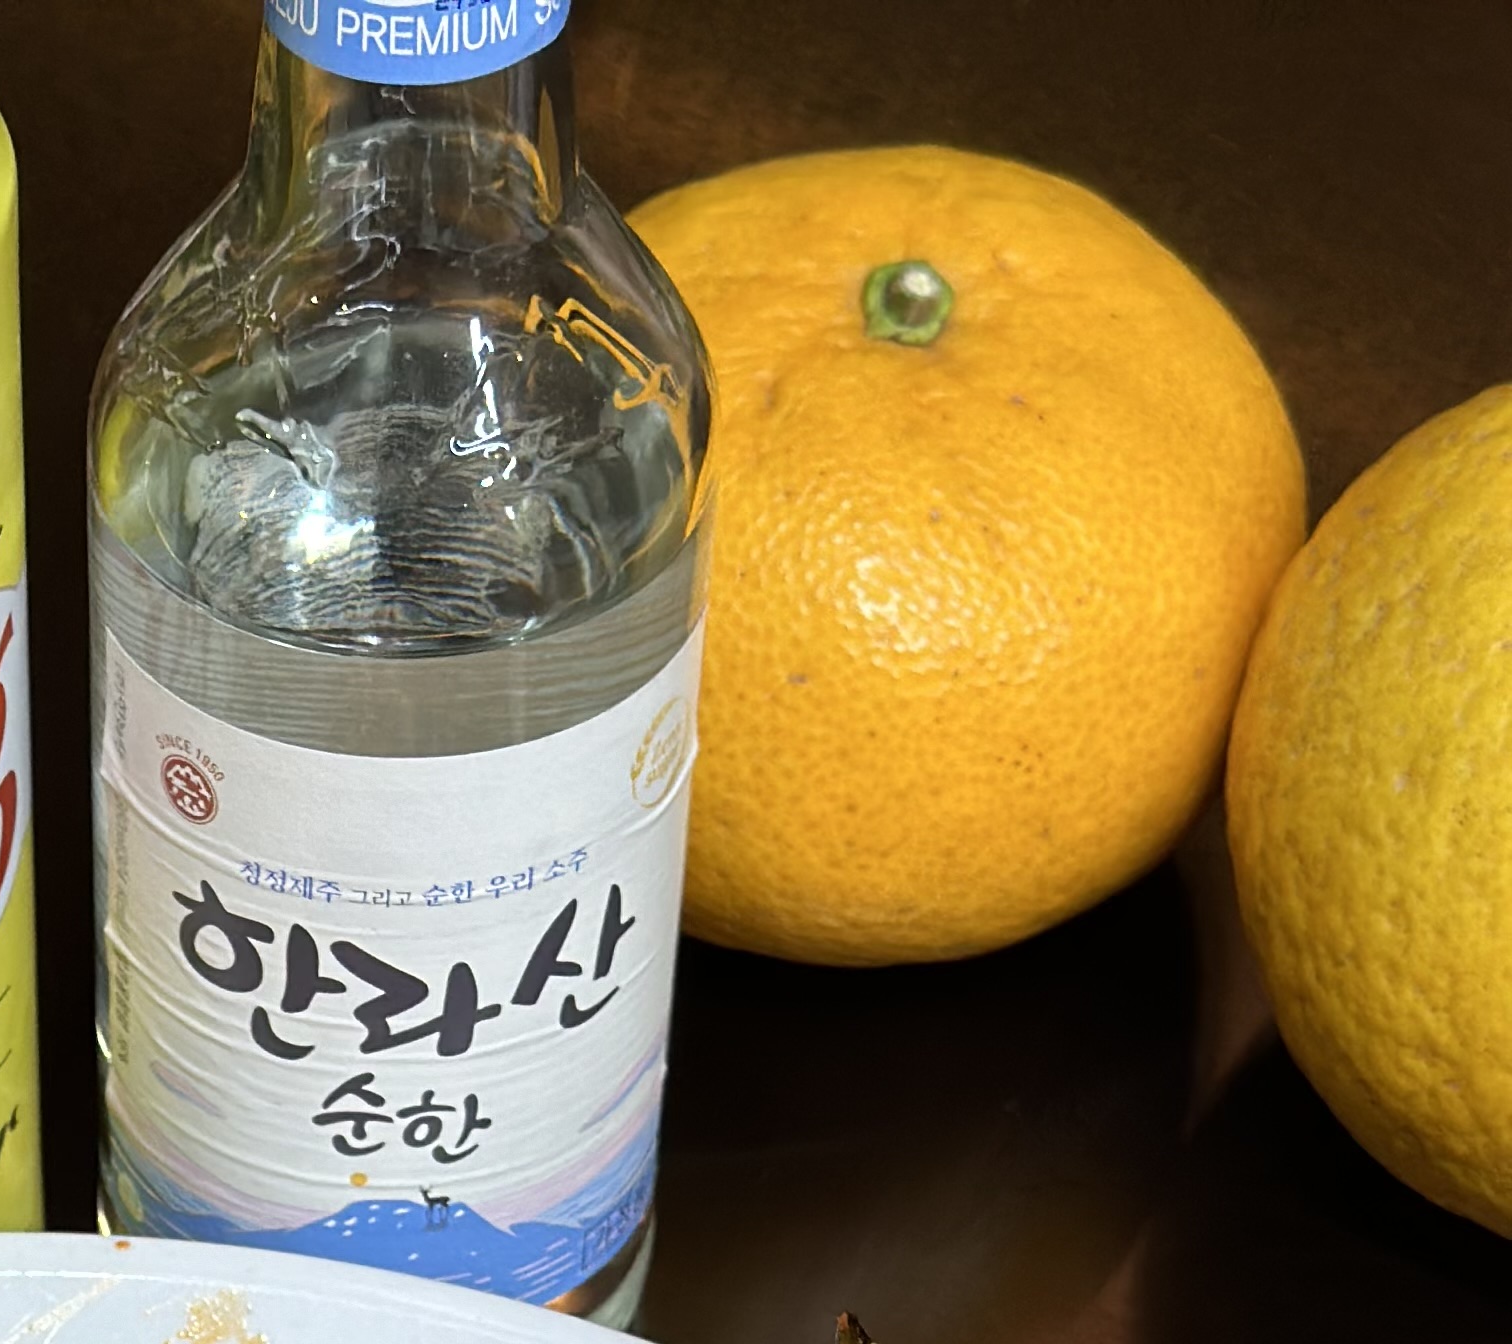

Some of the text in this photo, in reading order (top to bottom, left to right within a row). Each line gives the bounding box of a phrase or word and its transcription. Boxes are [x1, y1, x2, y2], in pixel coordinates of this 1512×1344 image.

[336, 0, 517, 56] PREMIUM
[240, 846, 587, 908] 청정제주 그리고 순한 우리 소주
[172, 880, 636, 1061] 한라산
[312, 1071, 492, 1164] 순한
